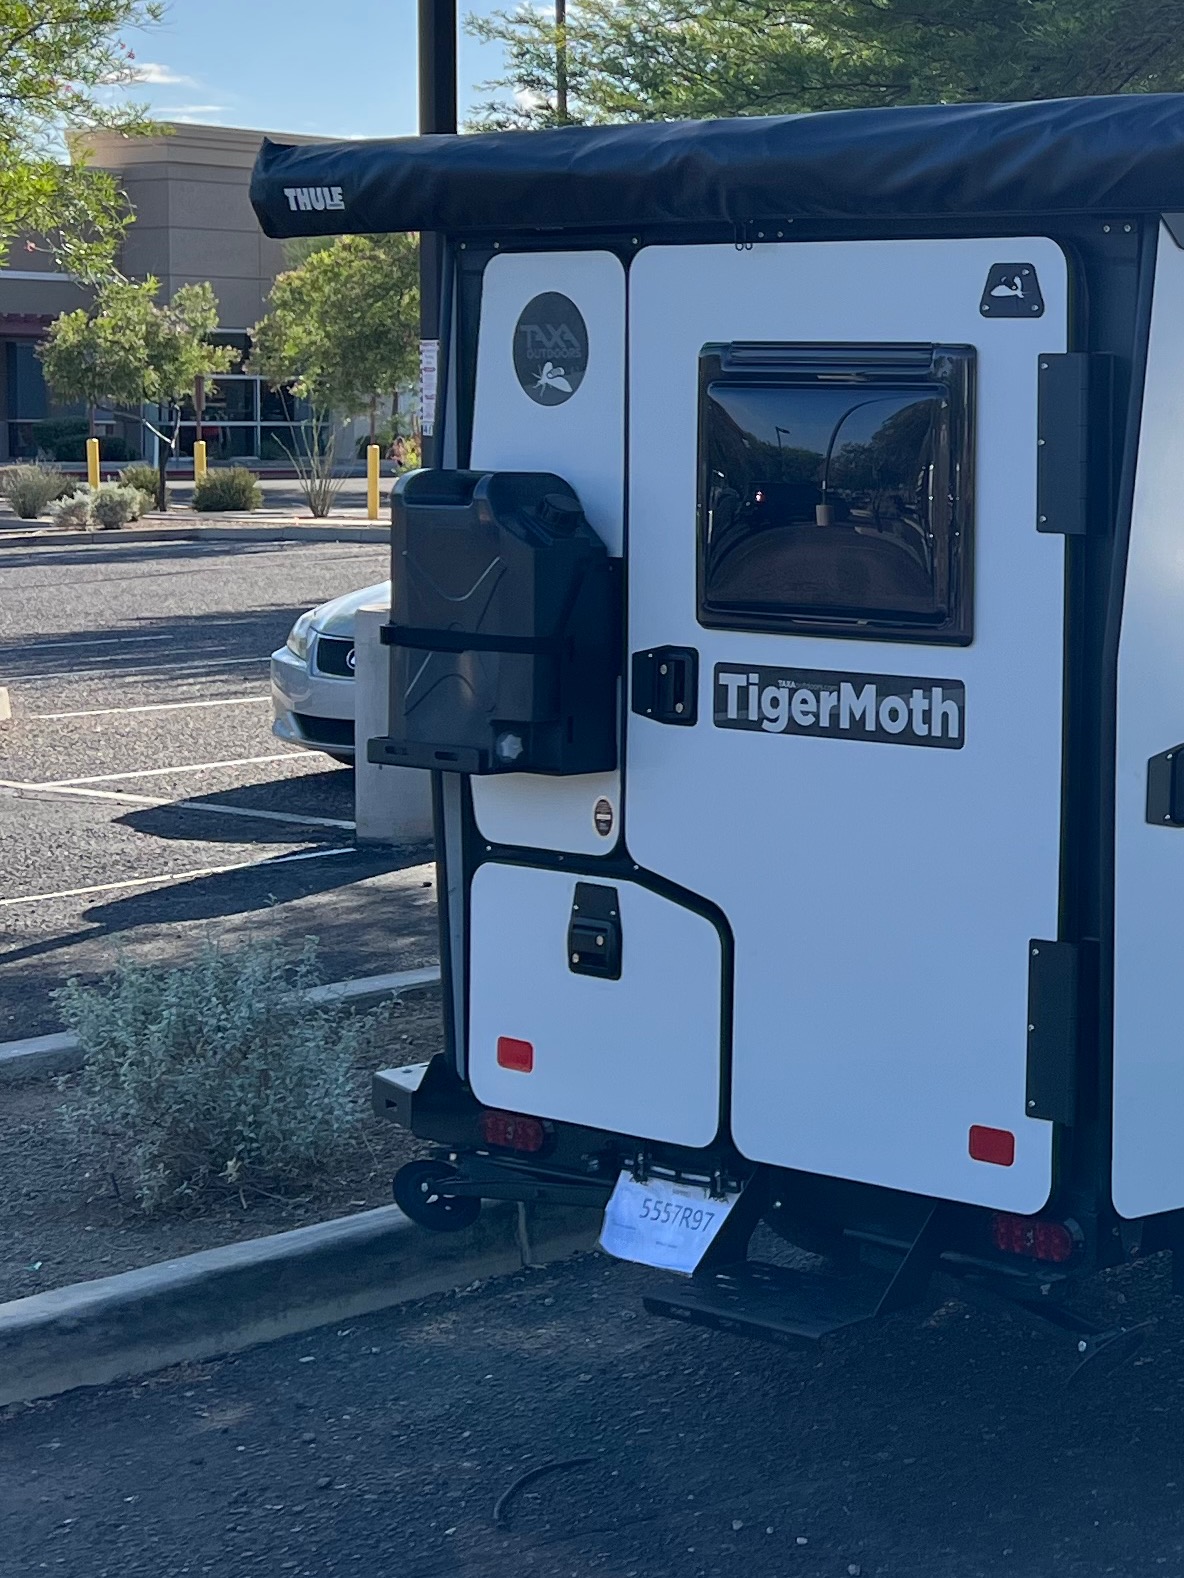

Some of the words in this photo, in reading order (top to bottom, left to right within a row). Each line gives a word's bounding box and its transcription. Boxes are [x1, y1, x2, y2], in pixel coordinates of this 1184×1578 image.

[283, 186, 345, 211] THULE
[520, 323, 580, 349] TAXA
[718, 672, 960, 739] TigerMoth
[639, 1198, 715, 1232] 5557R97
